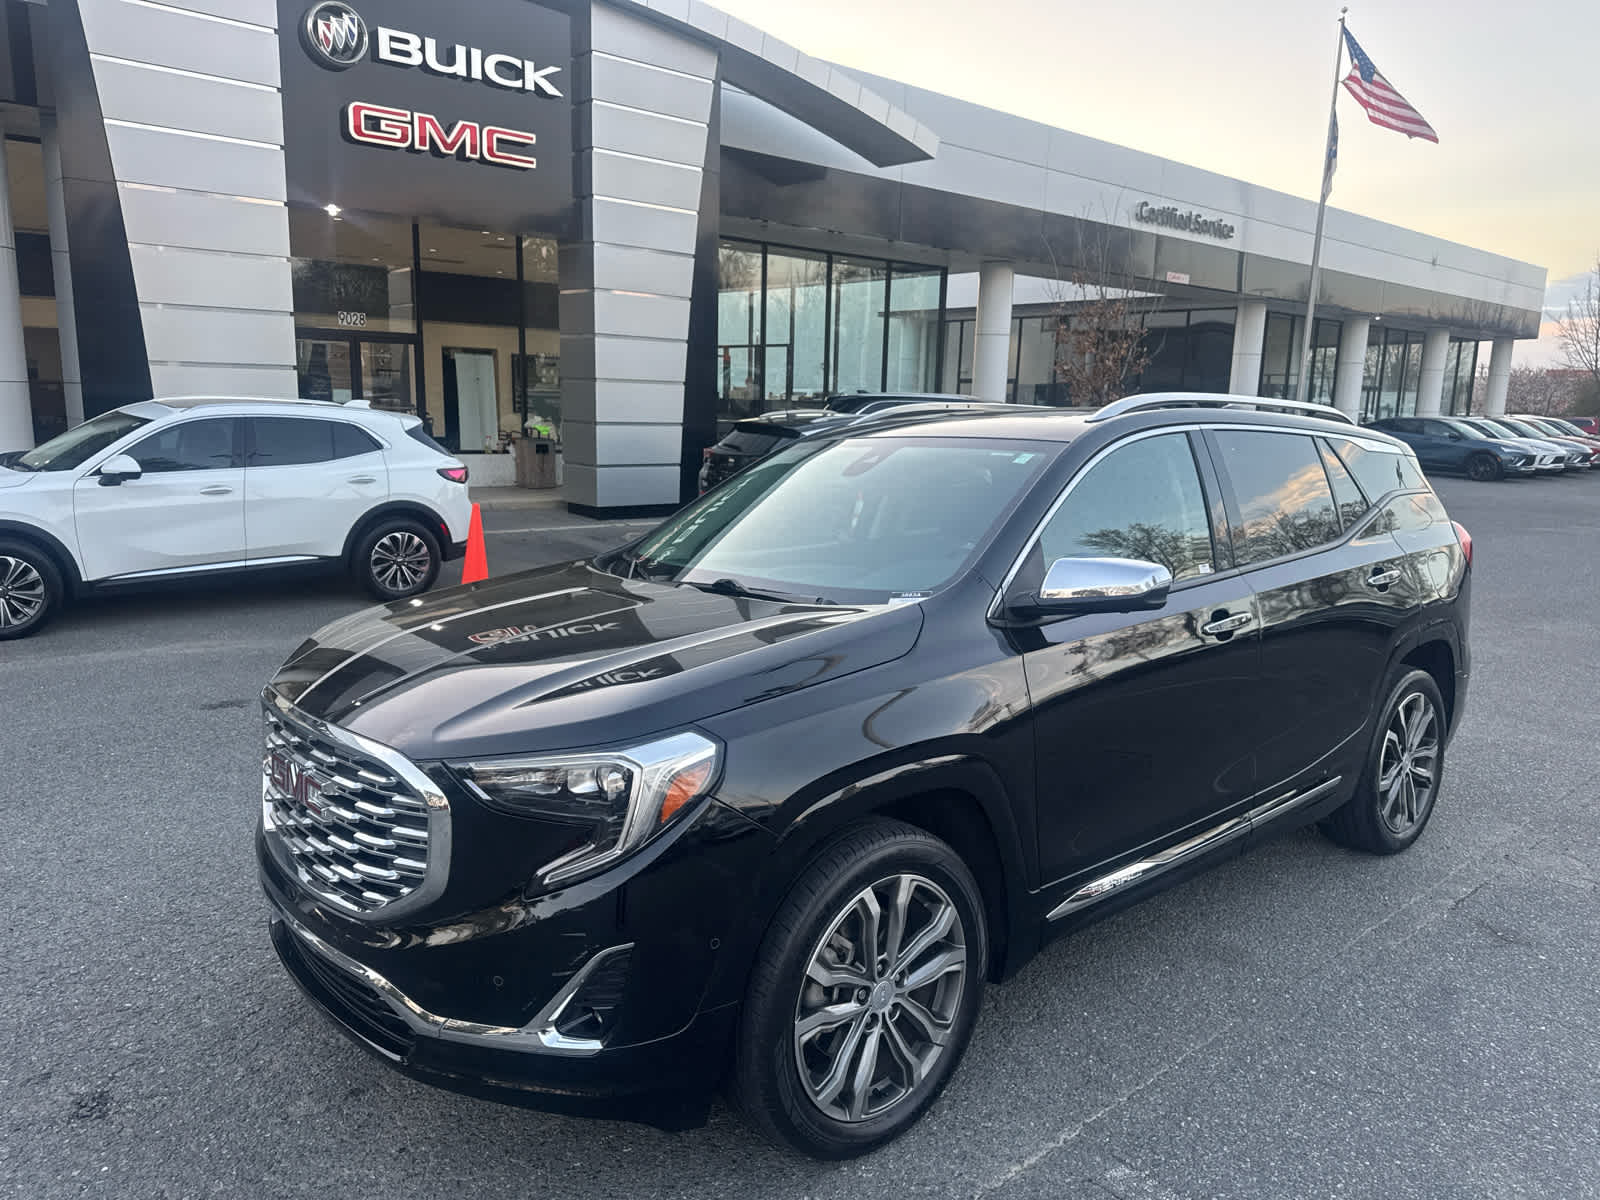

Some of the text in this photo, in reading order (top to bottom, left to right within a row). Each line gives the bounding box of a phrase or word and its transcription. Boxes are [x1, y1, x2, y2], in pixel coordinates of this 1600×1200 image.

[378, 26, 564, 97] BUICK
[347, 101, 537, 169] GMC
[1136, 201, 1235, 240] Certified Service
[338, 311, 367, 327] 9028
[271, 752, 322, 815] GMC
